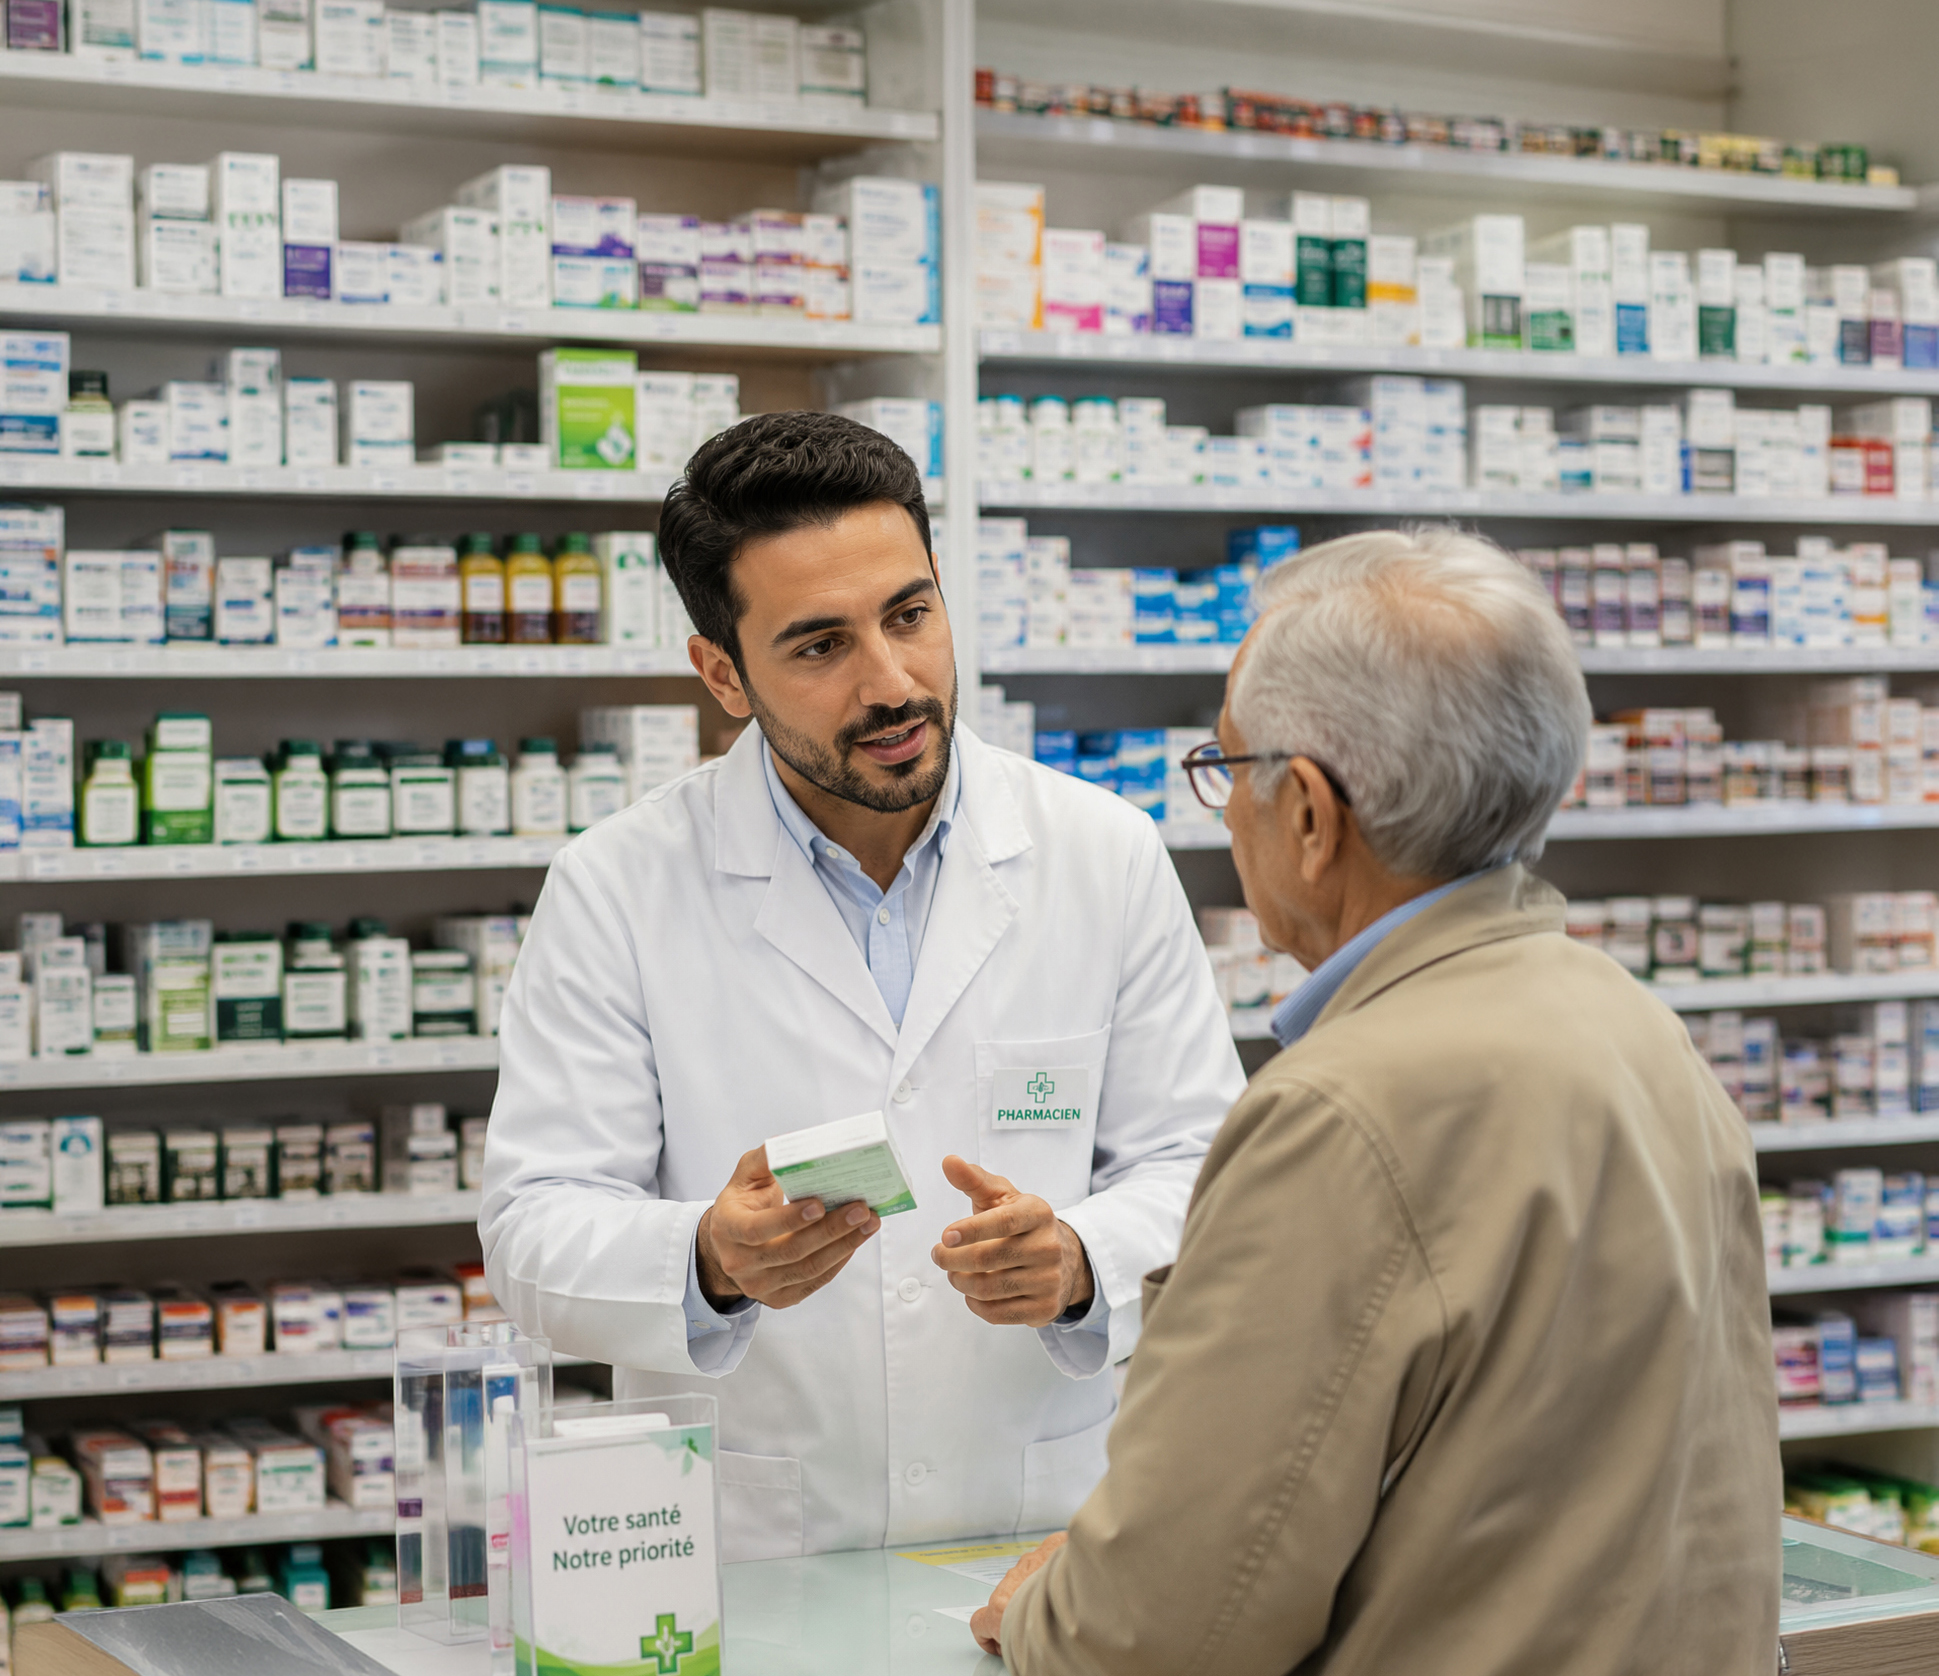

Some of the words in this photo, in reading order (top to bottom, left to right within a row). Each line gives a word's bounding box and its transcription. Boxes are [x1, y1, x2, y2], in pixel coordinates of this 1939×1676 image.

[997, 1108, 1081, 1121] PHARMACIEN
[563, 1514, 620, 1536] Votre
[625, 1503, 682, 1530] santé
[553, 1549, 613, 1571] Notre
[618, 1535, 695, 1569] priorité
